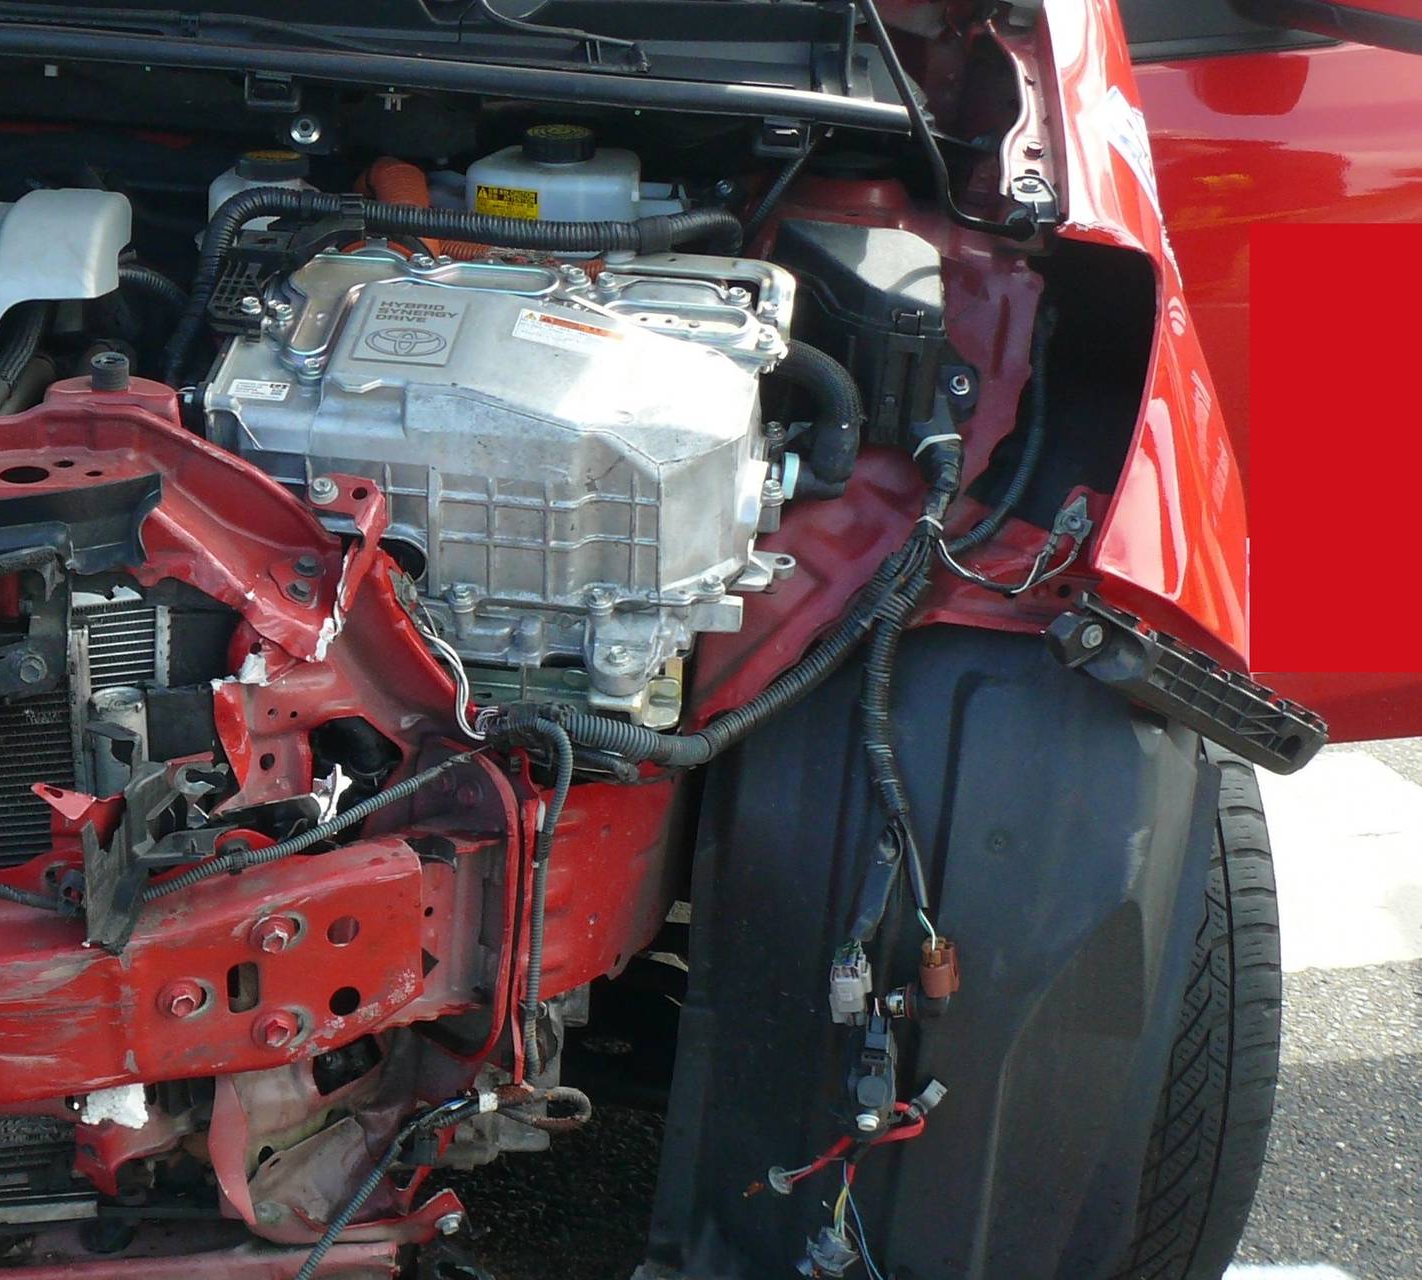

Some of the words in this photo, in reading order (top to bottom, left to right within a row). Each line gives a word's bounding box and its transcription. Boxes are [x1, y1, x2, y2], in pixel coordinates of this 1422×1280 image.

[380, 301, 445, 311] HYBRID
[378, 307, 458, 319] SYNERGY
[375, 314, 427, 323] DRIVE
